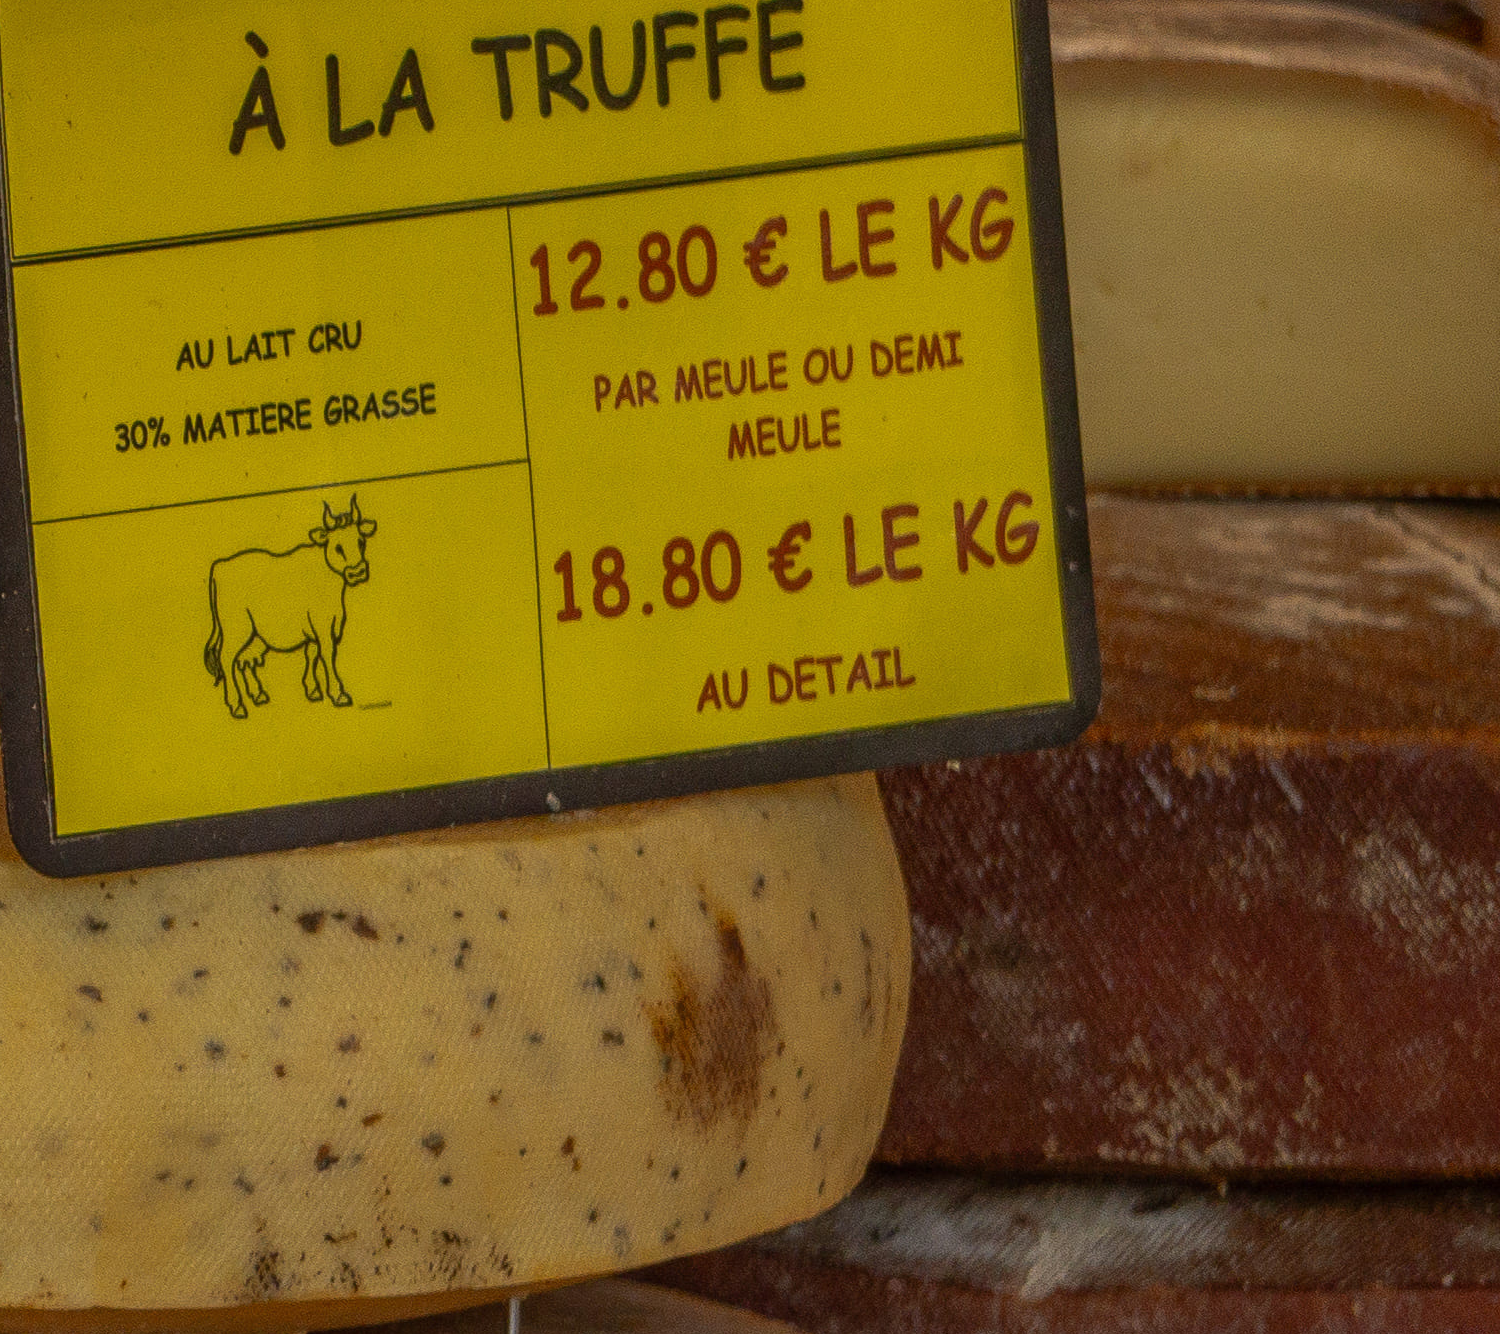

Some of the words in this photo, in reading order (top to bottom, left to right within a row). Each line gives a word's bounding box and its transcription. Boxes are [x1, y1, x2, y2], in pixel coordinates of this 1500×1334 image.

[228, 30, 287, 156] À
[324, 47, 436, 148] LA
[529, 224, 719, 317] 12.80
[742, 215, 790, 289] €
[818, 198, 898, 284] LE
[928, 186, 1016, 271] KG
[175, 338, 216, 372] AU
[225, 327, 297, 367] LAIT
[307, 319, 364, 355] CRU
[593, 369, 660, 412] PAR
[673, 349, 789, 403] MEULE
[802, 344, 855, 387] OU
[869, 330, 964, 379] DEMI
[114, 416, 172, 454] 30%
[182, 396, 313, 445] MATIERE
[322, 381, 437, 428] GRASSE
[726, 407, 842, 461] MEULE
[553, 529, 743, 623] 18.80
[767, 520, 814, 594] €
[842, 502, 924, 588] LE
[953, 489, 1041, 575] KG
[696, 668, 750, 714] AU
[766, 646, 918, 706] DETAIL
